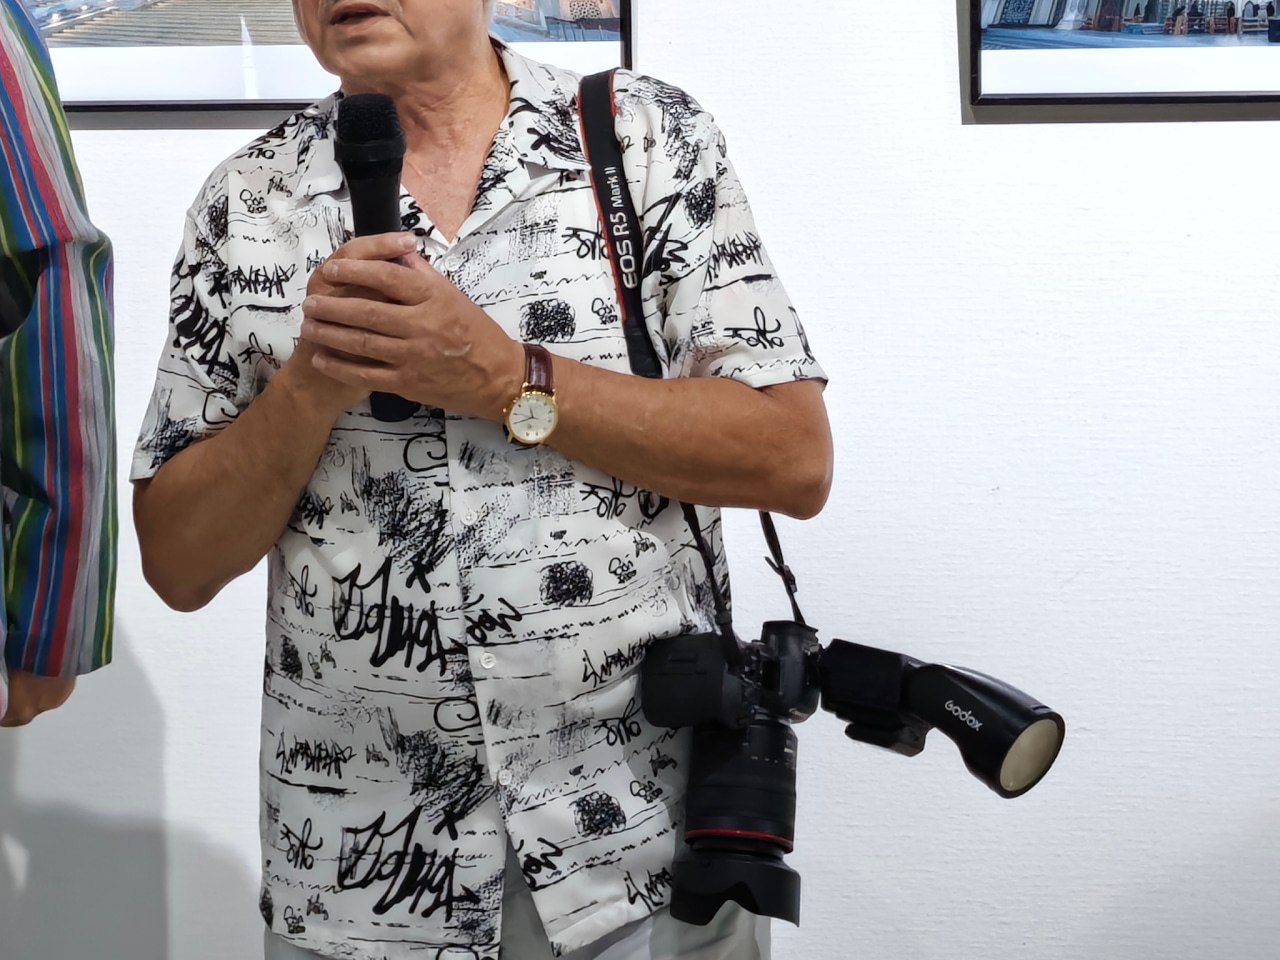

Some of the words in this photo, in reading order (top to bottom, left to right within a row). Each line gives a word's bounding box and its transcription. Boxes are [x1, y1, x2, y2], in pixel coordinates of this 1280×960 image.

[604, 166, 617, 176] II
[607, 176, 624, 208] Mark
[610, 212, 629, 237] R5
[616, 240, 638, 289] EOS
[944, 699, 983, 732] Godox
